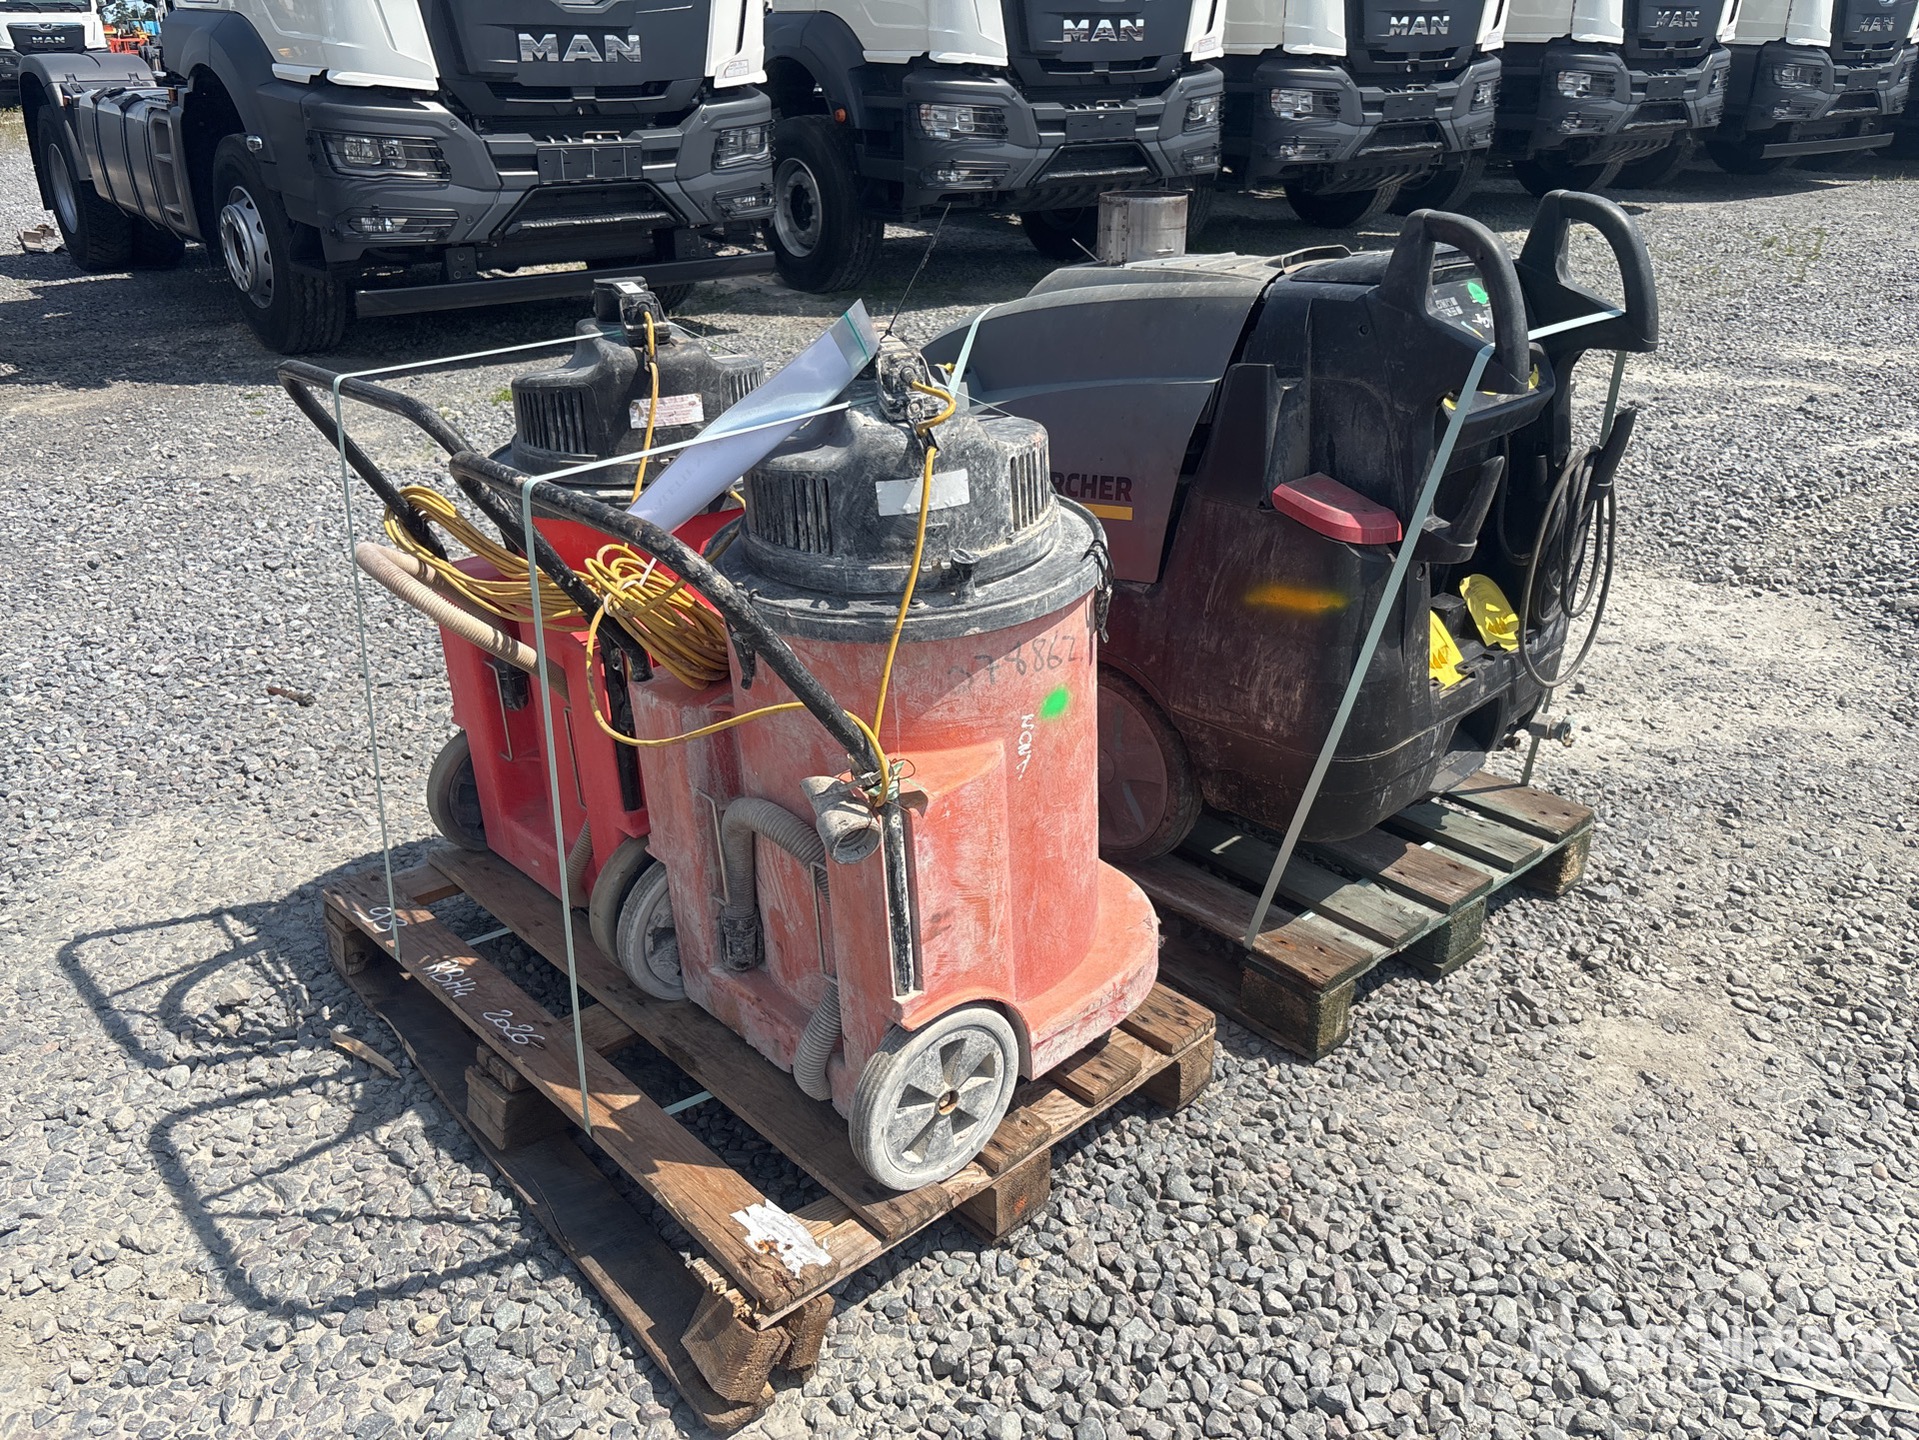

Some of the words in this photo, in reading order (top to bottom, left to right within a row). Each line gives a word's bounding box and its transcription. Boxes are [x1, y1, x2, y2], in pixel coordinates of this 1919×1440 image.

[1063, 19, 1144, 41] MAN
[1389, 15, 1450, 36] MAN
[1656, 11, 1700, 28] MAN
[1858, 16, 1896, 32] MAN
[31, 36, 66, 44] MAN
[518, 33, 642, 62] MAN
[1050, 472, 1132, 502] RCHER
[483, 1010, 546, 1044] 2026
